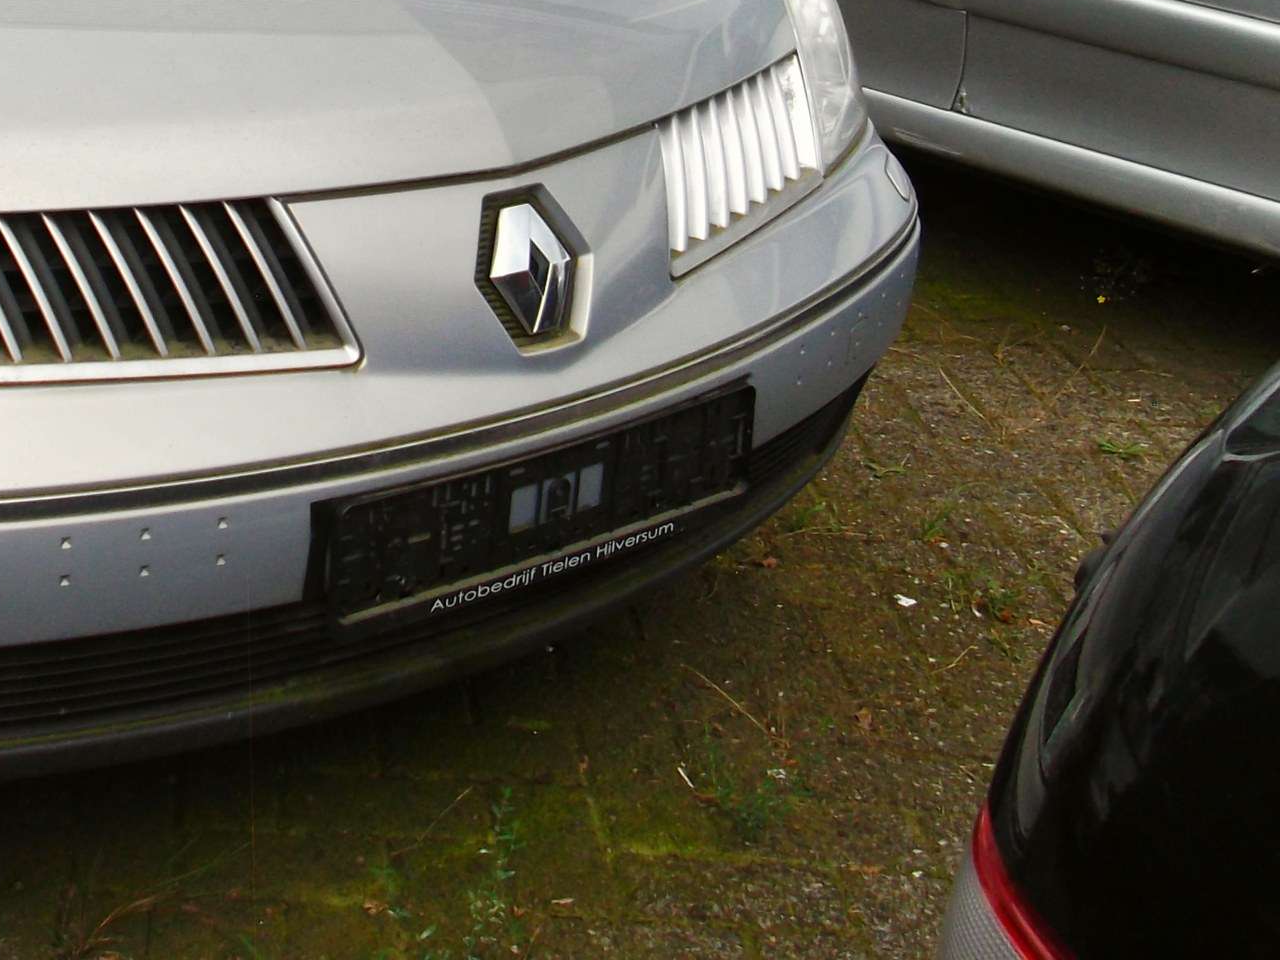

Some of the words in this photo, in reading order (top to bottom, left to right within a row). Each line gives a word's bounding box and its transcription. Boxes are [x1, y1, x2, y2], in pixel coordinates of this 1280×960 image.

[430, 569, 537, 613] Autobedrijf
[540, 551, 592, 579] Tielen
[595, 520, 675, 559] Hilversum
